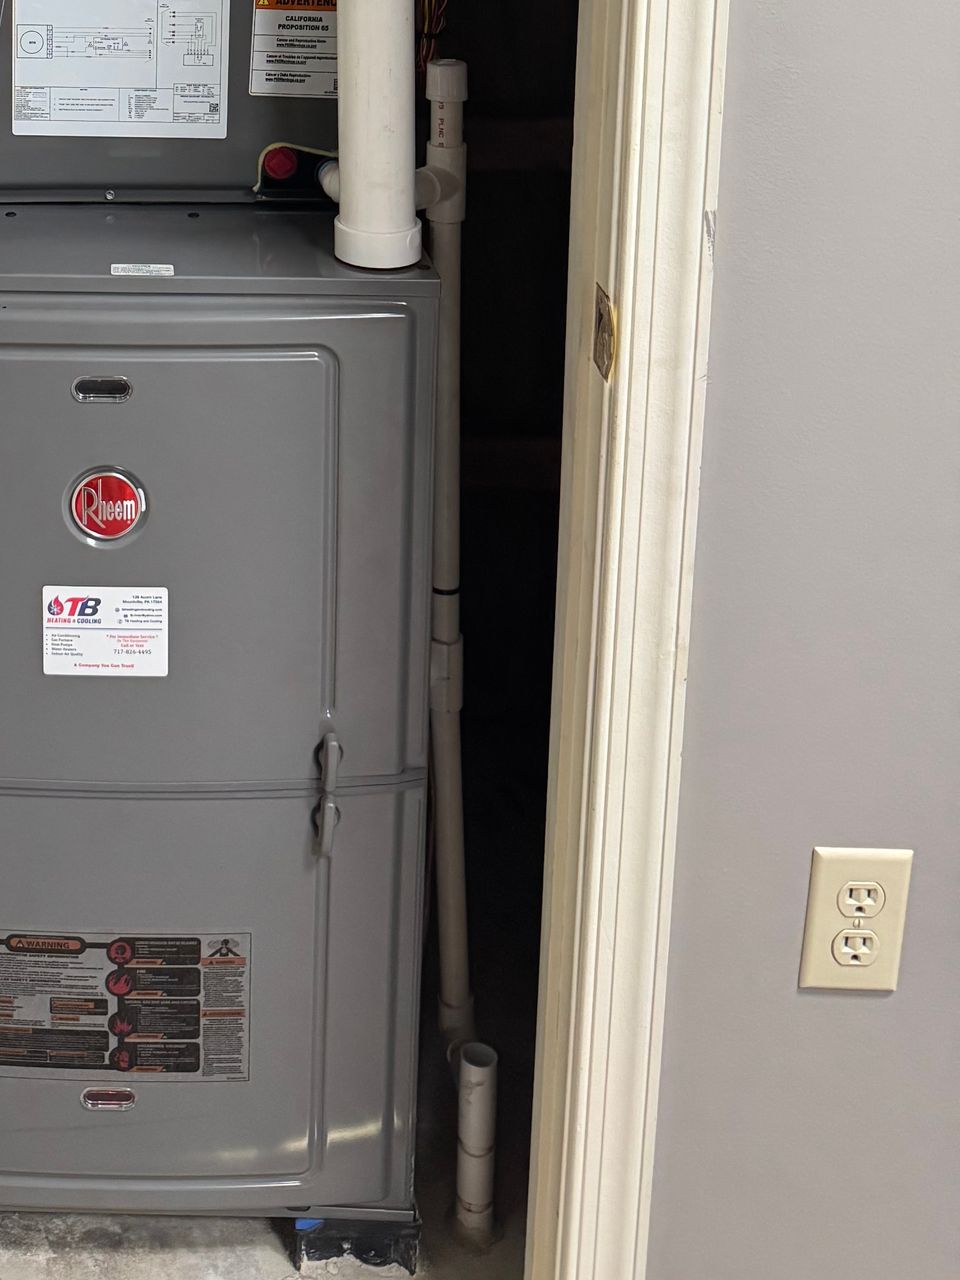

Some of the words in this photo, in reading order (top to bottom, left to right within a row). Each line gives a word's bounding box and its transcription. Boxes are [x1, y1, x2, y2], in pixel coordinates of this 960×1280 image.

[285, 15, 323, 23] CALIFORNIA
[277, 23, 320, 32] PROPOSITION
[81, 478, 136, 529] Rheem
[64, 596, 102, 617] TB
[26, 940, 70, 950] WARNING
